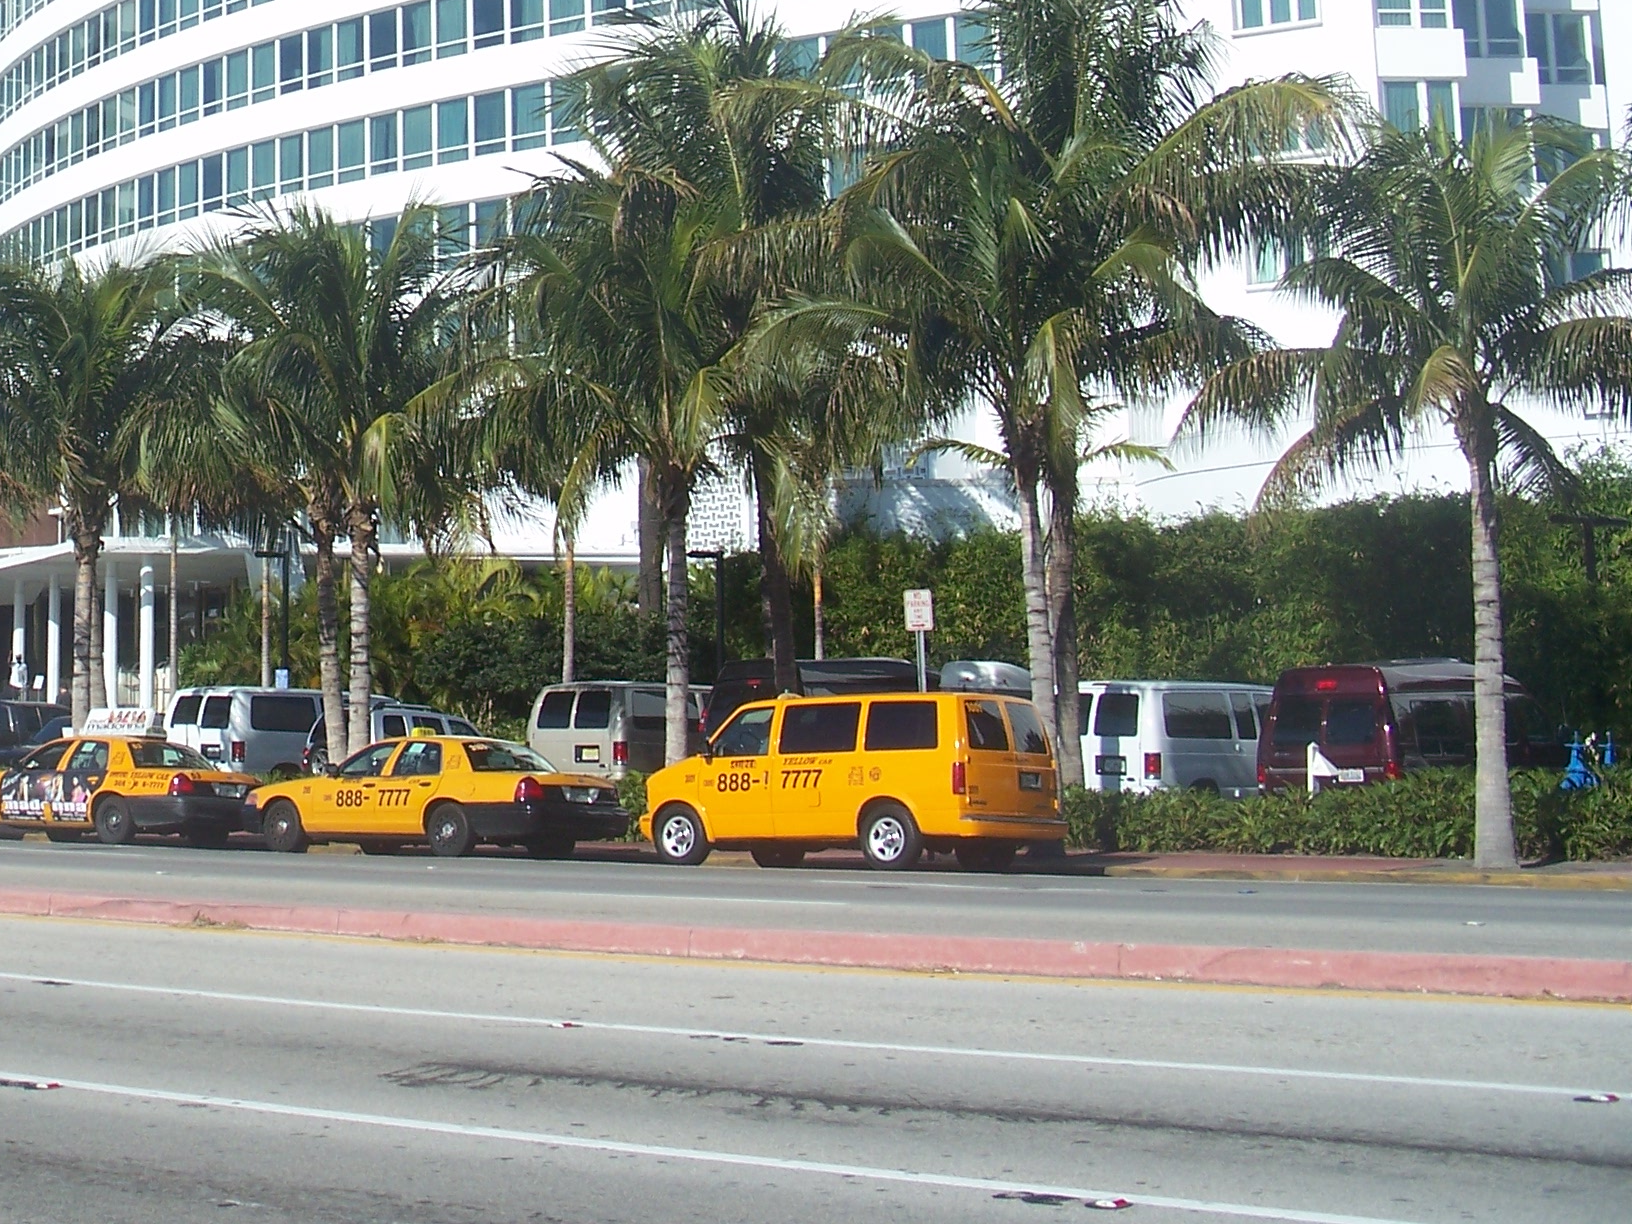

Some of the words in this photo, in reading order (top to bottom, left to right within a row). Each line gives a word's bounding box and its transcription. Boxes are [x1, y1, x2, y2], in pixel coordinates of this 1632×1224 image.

[783, 756, 818, 766] YELLOW
[780, 769, 823, 790] 7777
[378, 789, 411, 806] 7777
